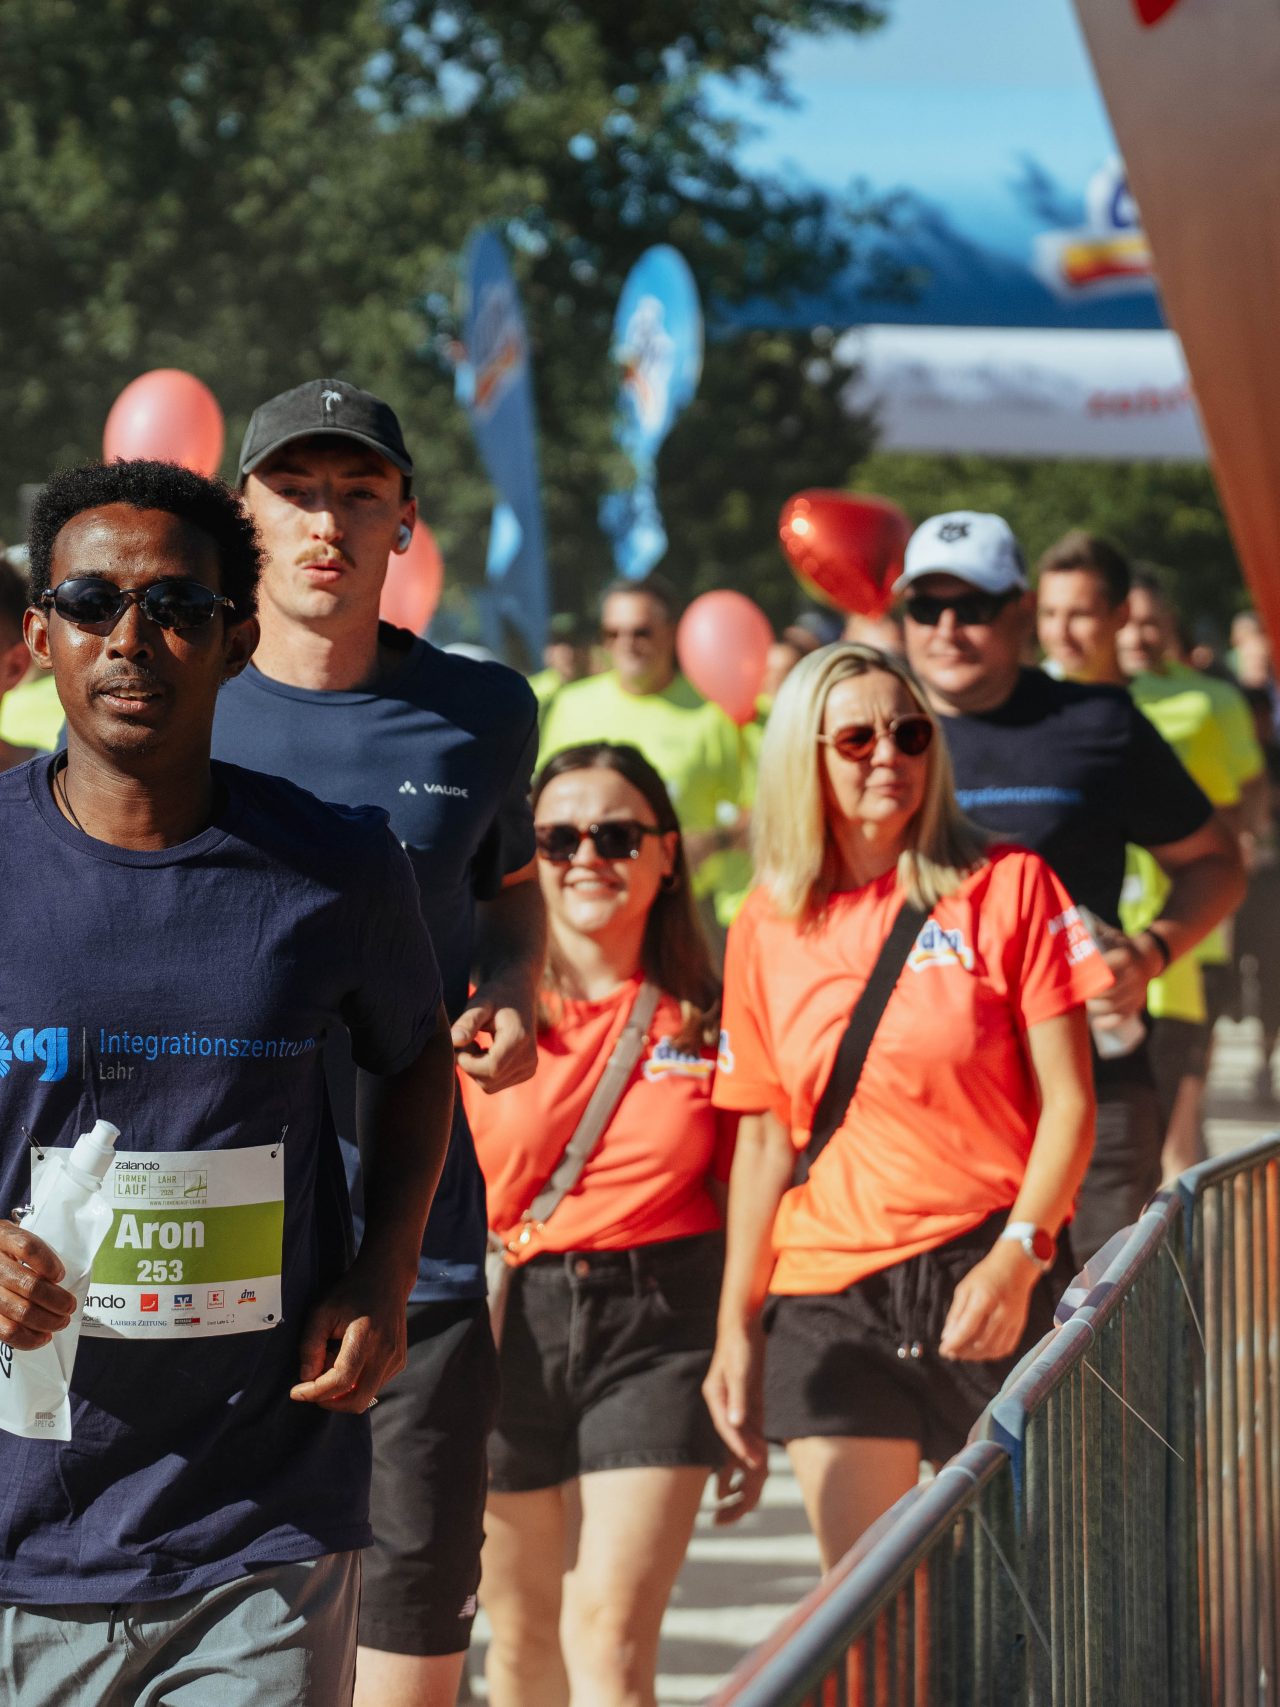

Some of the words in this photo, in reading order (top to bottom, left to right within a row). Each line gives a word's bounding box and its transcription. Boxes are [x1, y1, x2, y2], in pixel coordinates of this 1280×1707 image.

[423, 783, 469, 798] VAUDE
[98, 1027, 316, 1061] Integrationszentrum
[98, 1062, 135, 1080] Lahr
[114, 1160, 160, 1171] zalando
[118, 1174, 147, 1183] FIRMEN
[158, 1175, 177, 1184] LAHR
[118, 1184, 147, 1195] LAUF
[114, 1213, 205, 1249] Aron
[136, 1259, 184, 1282] 253
[240, 1288, 255, 1299] dm
